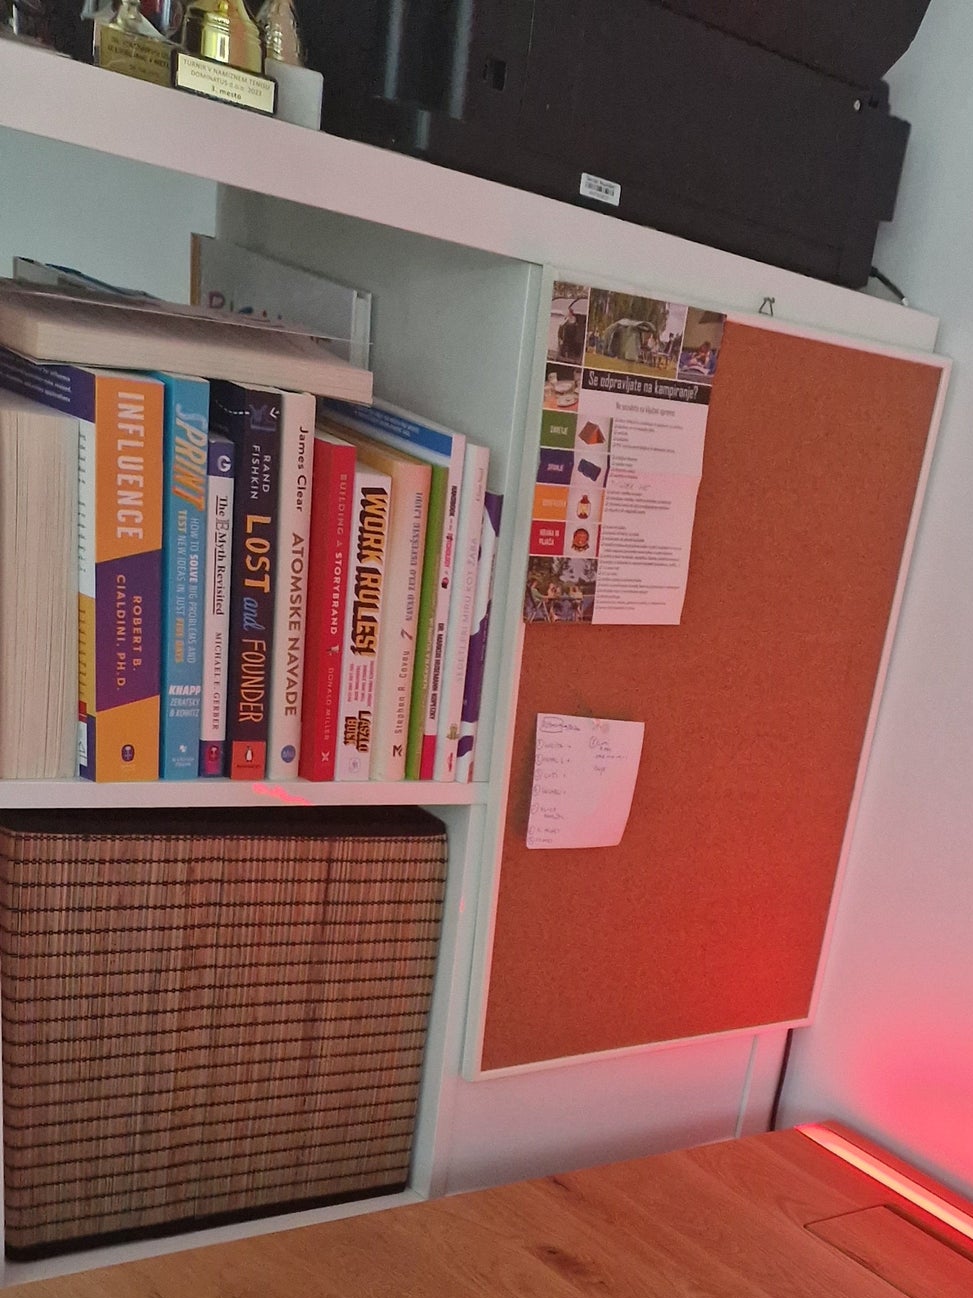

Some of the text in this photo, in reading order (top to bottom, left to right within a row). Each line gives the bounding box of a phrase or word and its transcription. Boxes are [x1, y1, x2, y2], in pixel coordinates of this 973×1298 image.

[219, 89, 242, 100] mesto
[588, 371, 699, 400] Se odpravljate na kampiranje?
[116, 391, 145, 540] INFLUENCE
[172, 402, 208, 511] SPRINT
[250, 444, 260, 500] FISHKIN
[262, 454, 272, 493] RAND
[296, 426, 309, 512] James Clear
[177, 510, 188, 534] TEST
[219, 495, 228, 517] The
[336, 473, 348, 535] BUILDING
[177, 535, 187, 554] NEW
[190, 518, 200, 539] HOW
[357, 487, 388, 566] WORK
[190, 541, 199, 552] TO
[215, 532, 227, 561] Myth
[176, 557, 186, 582] IDEAS
[189, 554, 199, 583] SOLVE
[175, 596, 185, 615] JUST
[215, 565, 226, 615] Revisited
[330, 552, 343, 635] STORYBRAND
[188, 601, 198, 645] PROBLEMS
[238, 514, 272, 723] LOST and FOUNDER
[284, 532, 305, 717] ATOMSKE NAVADE
[351, 566, 383, 658] RULES!
[132, 595, 142, 671] ROBERT B.
[400, 628, 413, 641] 7
[116, 652, 127, 691] PH.D.
[213, 632, 222, 677] MICHAEL
[399, 650, 410, 678] Covey
[168, 684, 201, 696] KNAPP
[323, 667, 335, 741] DONALD MILLER
[211, 692, 221, 730] GERBER
[394, 696, 406, 734] Stephen
[356, 710, 372, 753] LASZLO
